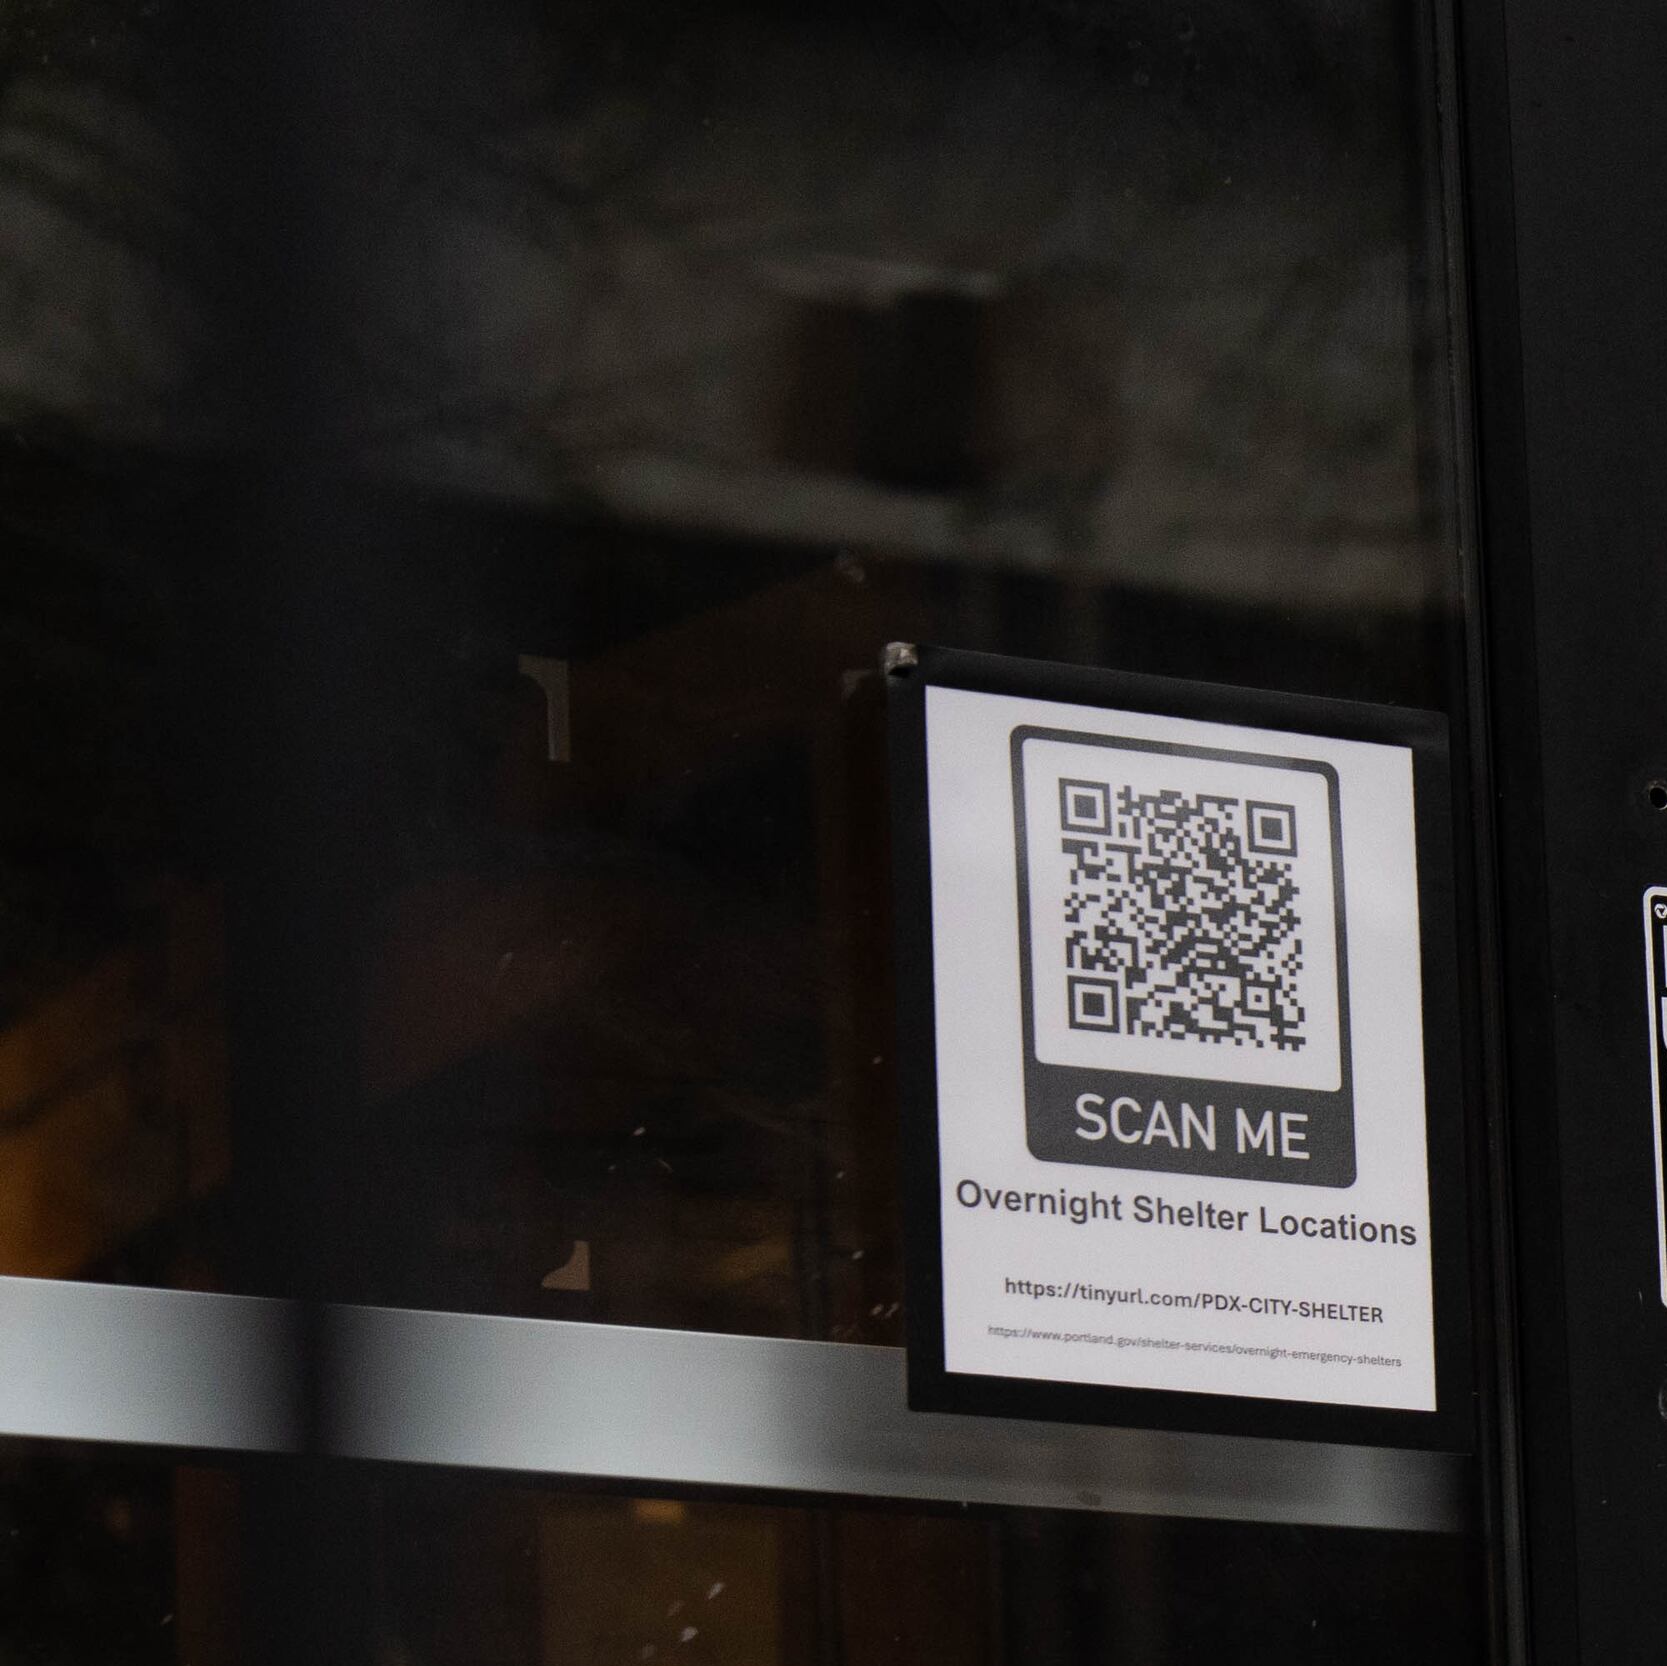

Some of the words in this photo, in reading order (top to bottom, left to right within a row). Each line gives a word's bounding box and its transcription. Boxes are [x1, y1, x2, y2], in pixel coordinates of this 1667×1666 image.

[1076, 1094, 1215, 1150] SCAN
[1237, 1108, 1309, 1159] ME
[958, 1180, 1122, 1224] Overnight
[1134, 1196, 1248, 1230] Shelter
[1260, 1207, 1416, 1245] Locations
[1006, 1278, 1383, 1323] https://tinyurl.com/PDX-CITY-SHELTER
